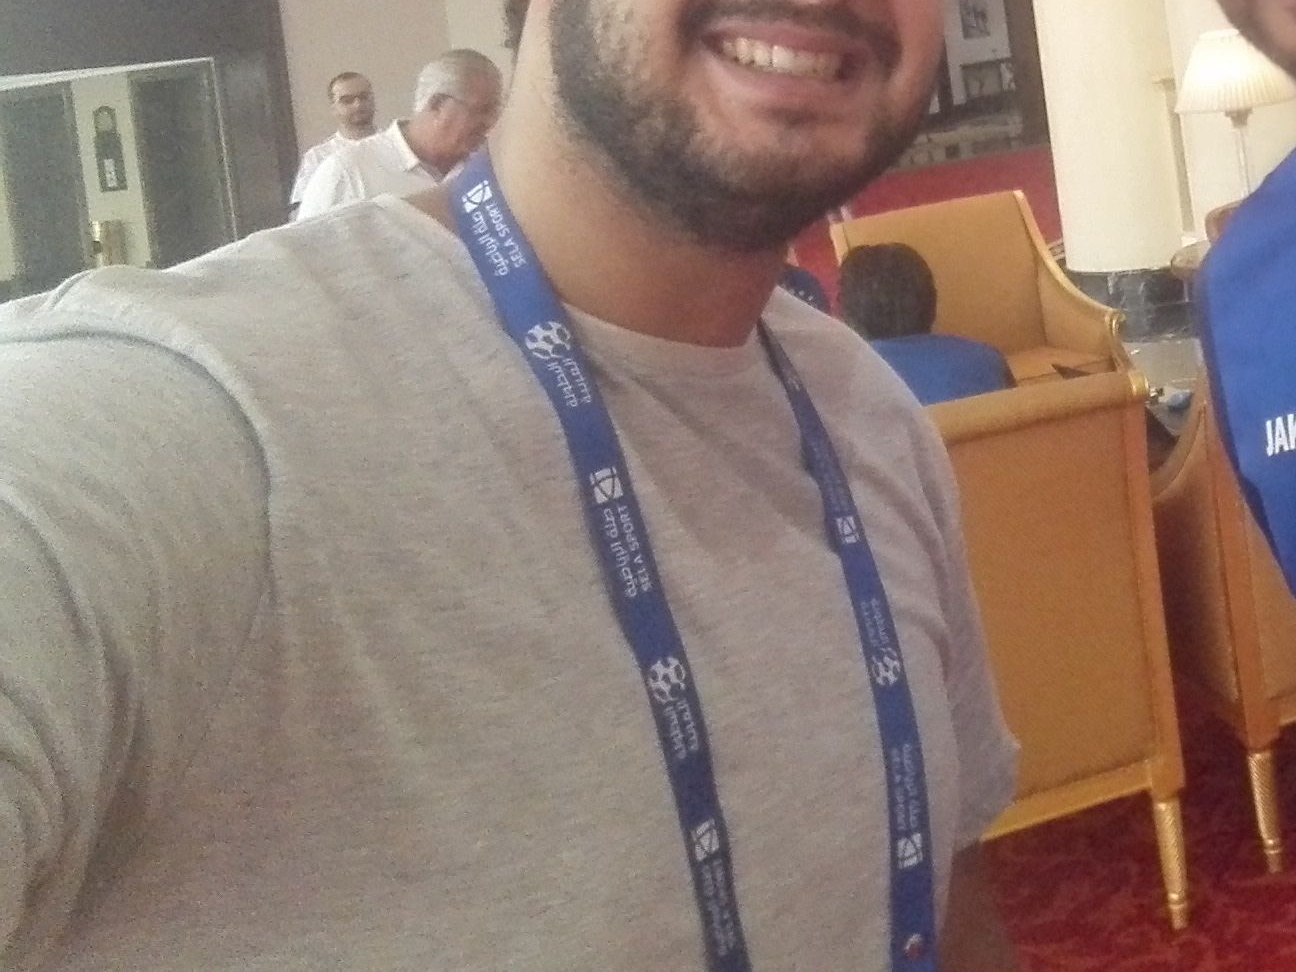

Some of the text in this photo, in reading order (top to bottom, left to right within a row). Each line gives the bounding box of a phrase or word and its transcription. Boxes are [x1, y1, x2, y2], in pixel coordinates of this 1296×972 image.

[484, 202, 525, 268] SELA SPORT
[617, 505, 640, 551] SPORT
